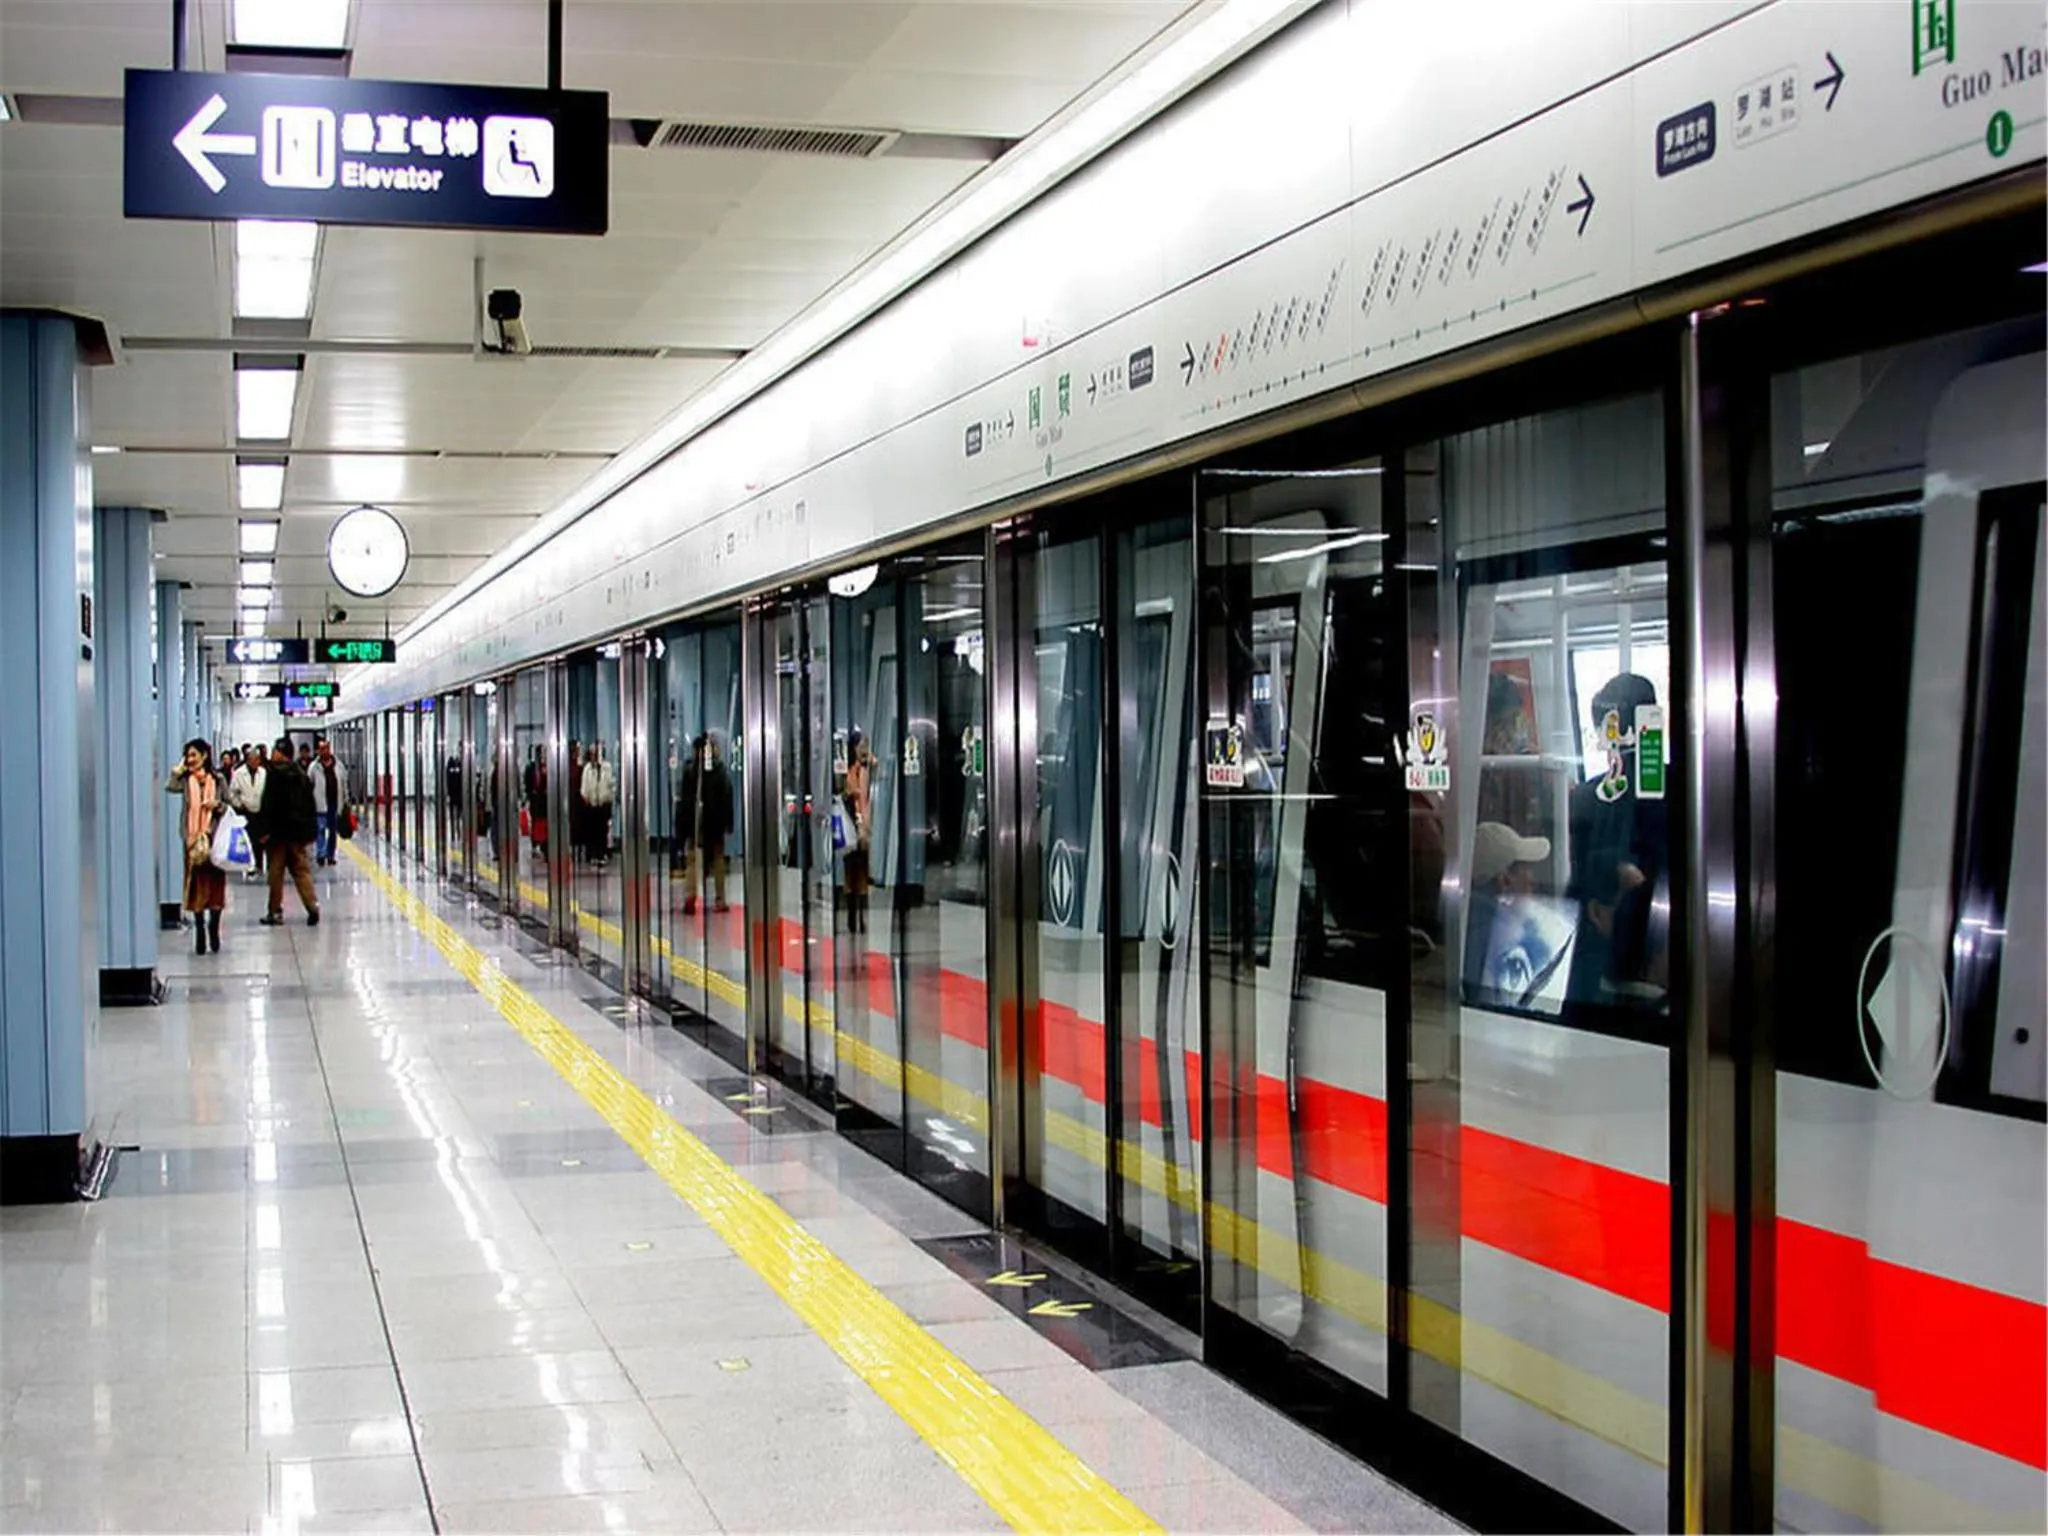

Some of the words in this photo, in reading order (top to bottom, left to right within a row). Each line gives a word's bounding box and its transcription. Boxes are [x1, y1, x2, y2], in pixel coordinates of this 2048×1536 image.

[1942, 71, 1991, 108] Guo
[2001, 46, 2048, 88] Ma
[341, 160, 443, 191] Elevator
